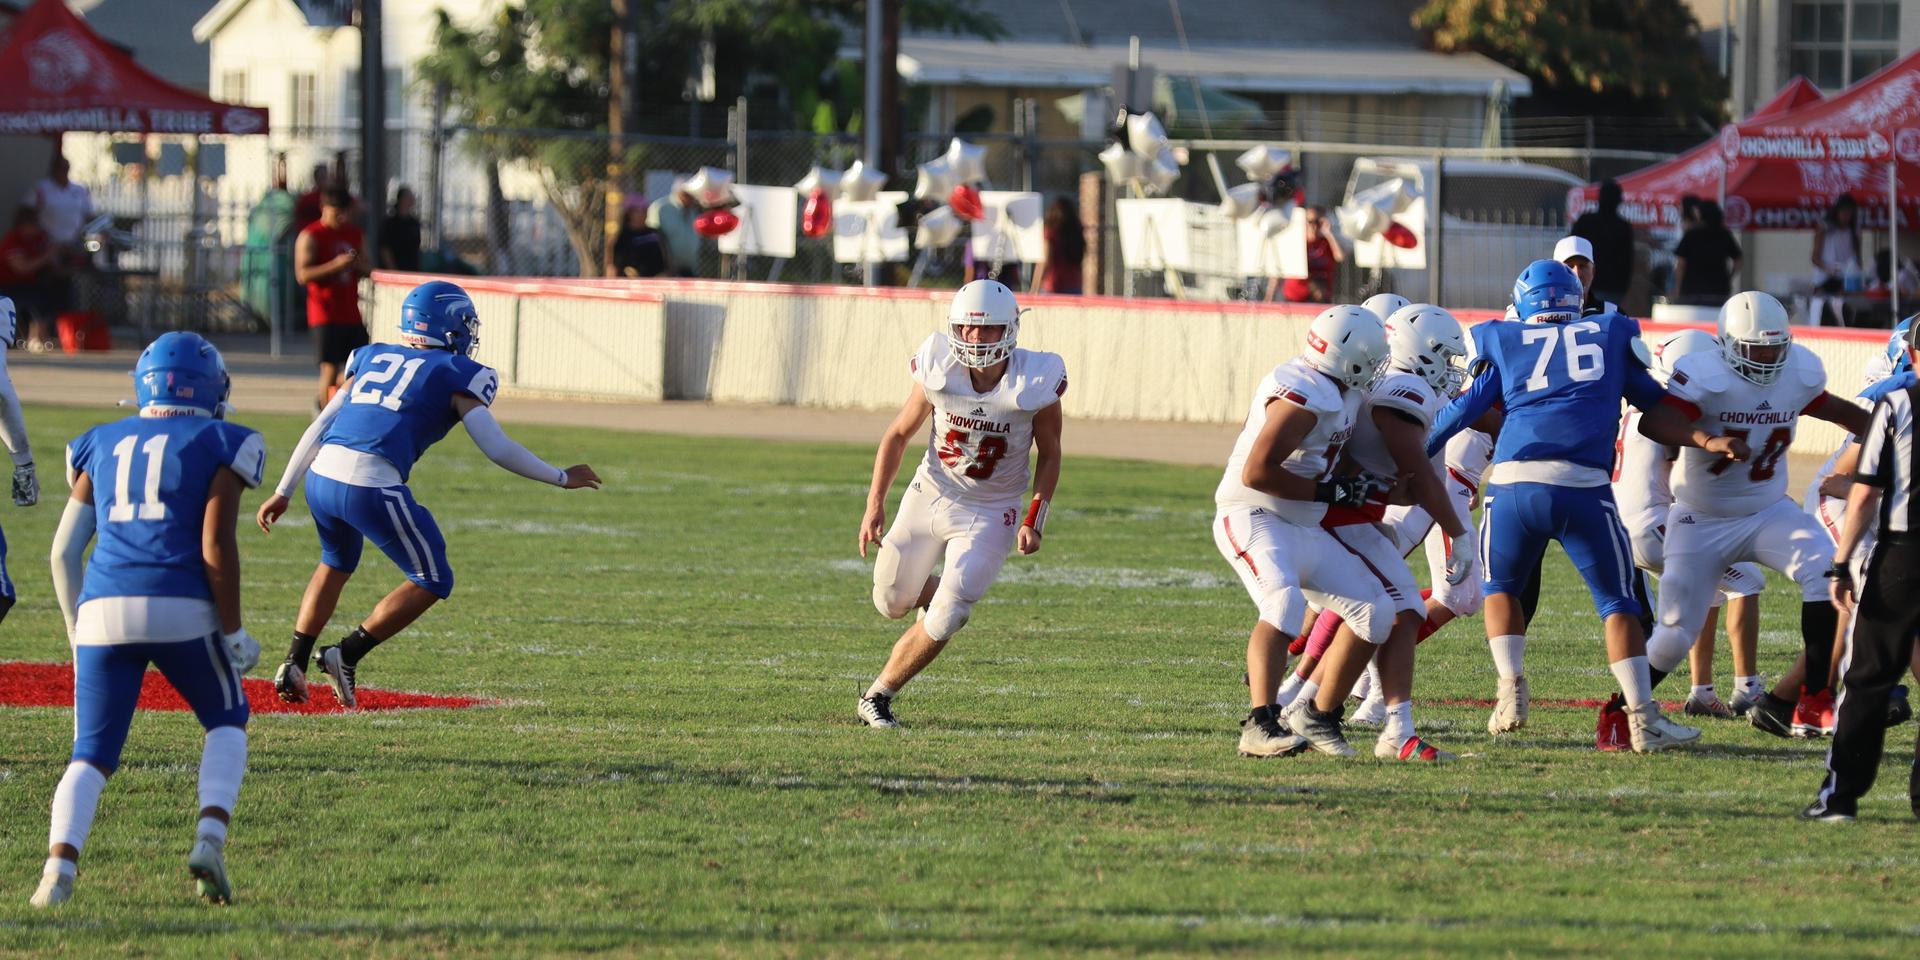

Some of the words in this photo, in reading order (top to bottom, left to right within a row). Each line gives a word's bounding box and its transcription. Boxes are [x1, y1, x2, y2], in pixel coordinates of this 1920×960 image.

[350, 352, 426, 412] 21
[1522, 320, 1605, 393] 76
[1719, 410, 1796, 424] CHOWCHILLA
[108, 434, 170, 522] 11
